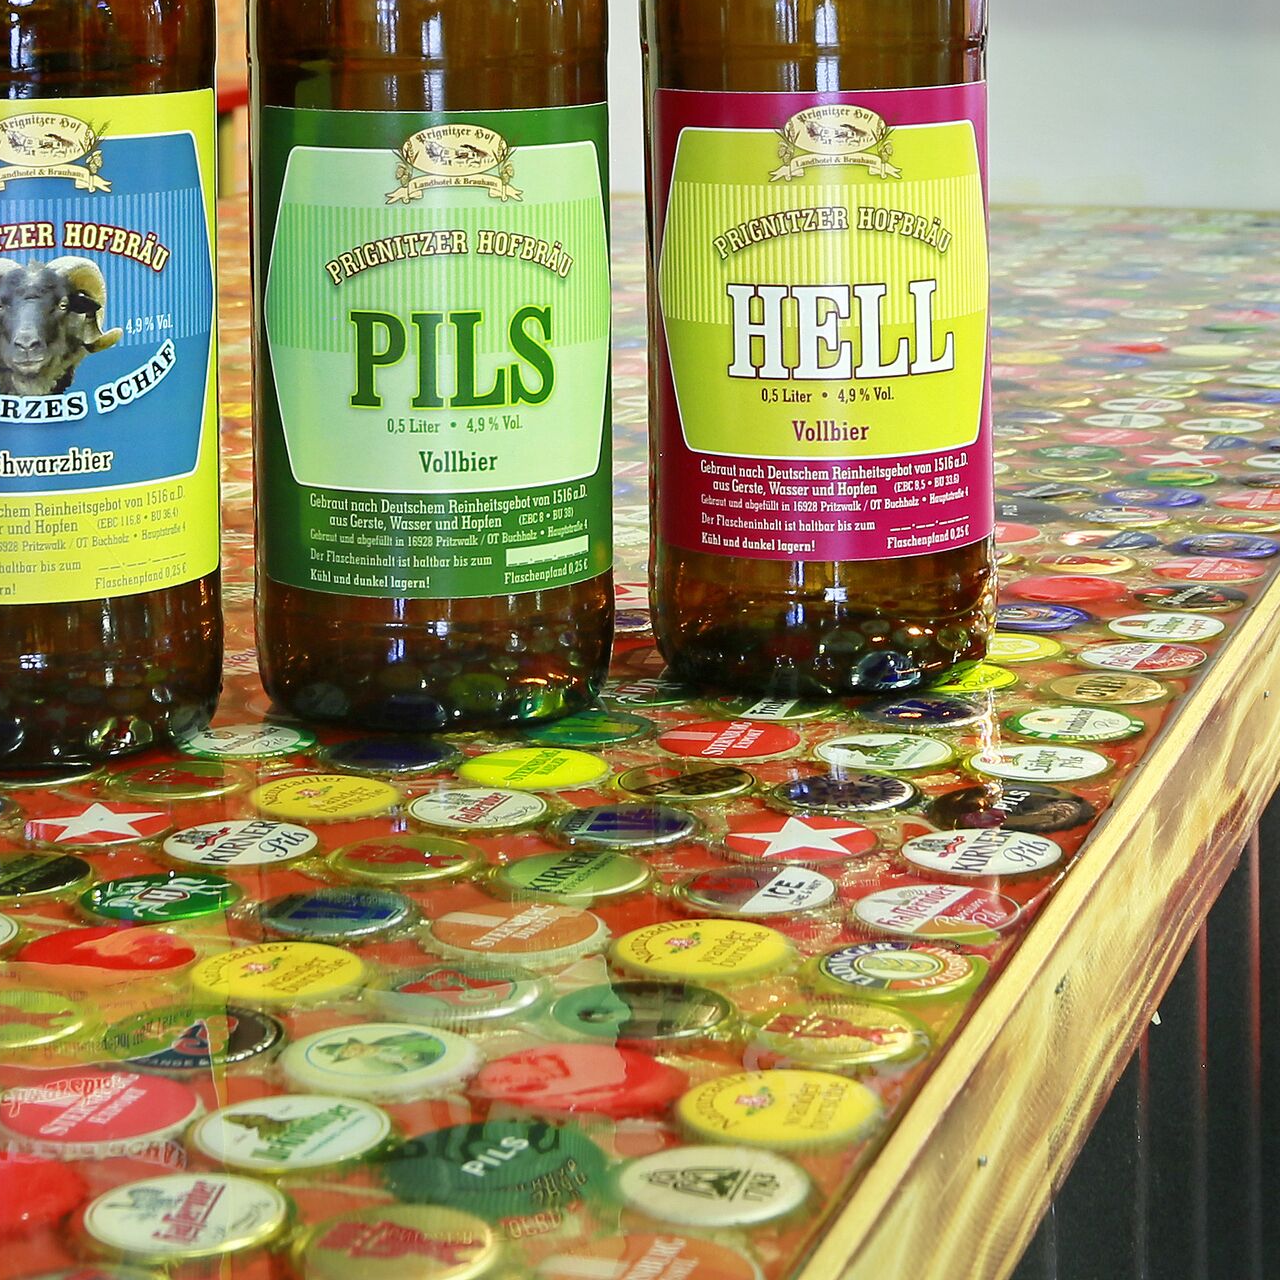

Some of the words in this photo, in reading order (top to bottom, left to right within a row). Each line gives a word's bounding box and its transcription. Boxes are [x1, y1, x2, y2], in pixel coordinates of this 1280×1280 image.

[48, 168, 85, 178] Brauhaus
[794, 158, 832, 168] Landhotel
[843, 156, 877, 167] Brauhaus
[413, 178, 452, 189] Landhotel
[463, 178, 498, 188] Brauhaus
[713, 207, 848, 260] PRIGNITZER
[858, 207, 952, 254] HOFBRÄU
[64, 222, 171, 272] HOFBRÄU
[325, 230, 468, 285] PRIGNITZER
[478, 230, 574, 280] HOFBRÄU
[125, 319, 142, 334] 4,9
[145, 318, 154, 331] %
[157, 314, 174, 330] Vol.
[726, 278, 955, 380] HELL
[348, 304, 556, 410] PILS
[97, 341, 176, 411] SCHAF
[761, 388, 778, 403] 0,5
[782, 388, 812, 403] Liter
[838, 388, 856, 403] 4,9
[860, 389, 870, 401] %
[874, 387, 894, 401] Vol.
[387, 419, 406, 433] 0,5
[409, 419, 439, 434] Liter
[467, 418, 485, 433] 4,9
[488, 418, 499, 431] %
[502, 415, 523, 430] Vol.
[792, 421, 869, 441] Vollbier
[419, 451, 498, 473] Vollbier
[700, 459, 736, 477] Gebraut
[739, 464, 764, 478] nach
[768, 465, 828, 481] Deutschem
[832, 463, 912, 482] Reinheitsgebot
[914, 462, 932, 474] von
[934, 457, 953, 472] 1516
[713, 481, 729, 492] aus
[732, 479, 766, 497] Gerste,
[770, 481, 809, 496] Wasser
[812, 482, 834, 496] und
[838, 481, 877, 499] Hopfen
[35, 498, 121, 518] Reinheitsgebot
[124, 498, 142, 509] von
[146, 491, 168, 506] 1516
[310, 493, 348, 511] Gebraut
[351, 499, 378, 513] nach
[381, 499, 445, 515] Deutschem
[448, 496, 531, 515] Reinheitsgebot
[533, 496, 550, 507] von
[553, 488, 572, 505] 1516
[8, 521, 31, 534] und
[35, 519, 78, 538] Hopfen
[330, 516, 347, 528] aus
[350, 515, 386, 530] Gerste,
[390, 517, 432, 530] Wasser
[435, 516, 458, 530] und
[462, 515, 502, 533] Hopfen
[701, 512, 714, 525] Der
[717, 515, 782, 531] Flascheninhalt
[785, 518, 796, 531] ist
[799, 518, 835, 532] haltbar
[838, 519, 851, 532] bis
[854, 521, 875, 531] zum
[702, 532, 721, 545] Kühl
[724, 536, 739, 549] und
[742, 537, 775, 551] dunkel
[778, 539, 815, 554] lagern!
[887, 528, 949, 550] Flaschenpfand
[997, 790, 1030, 813] PILS
[201, 821, 281, 863] KIRNER
[259, 830, 309, 858] Pils
[952, 830, 1017, 873] KIRNER
[1003, 837, 1051, 868] Pils
[762, 879, 805, 901] ICE
[461, 1135, 530, 1178] PILS
